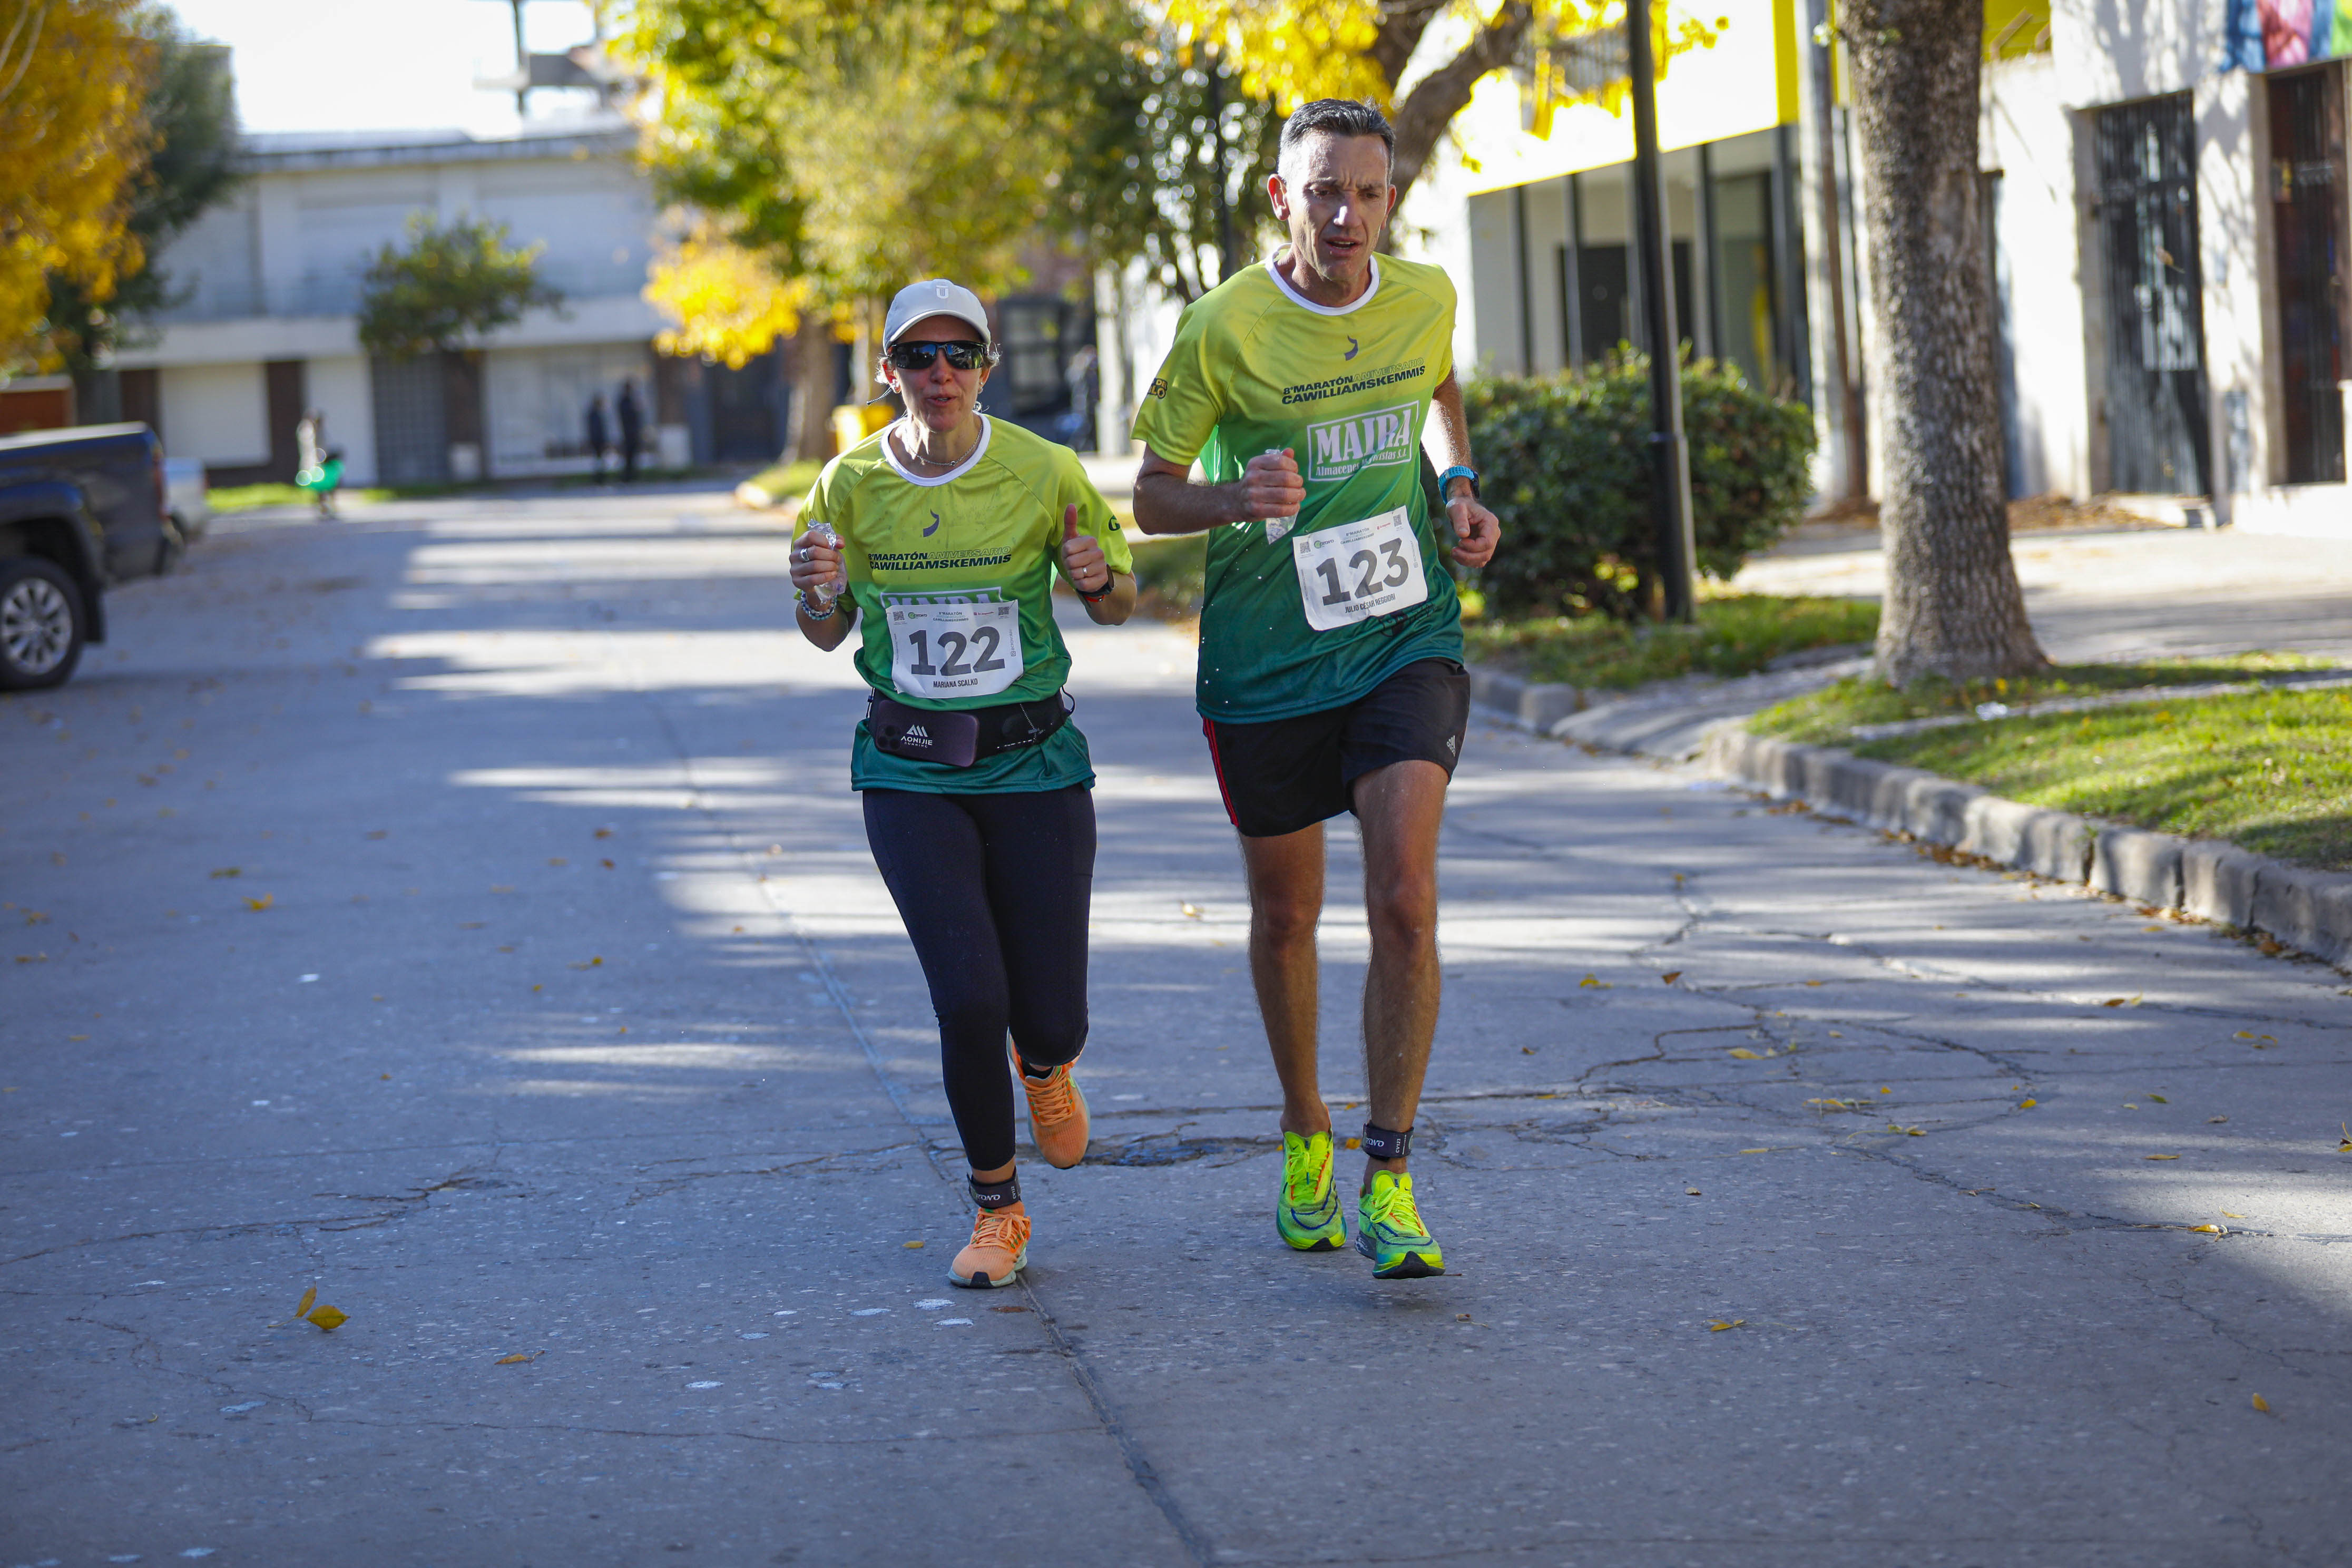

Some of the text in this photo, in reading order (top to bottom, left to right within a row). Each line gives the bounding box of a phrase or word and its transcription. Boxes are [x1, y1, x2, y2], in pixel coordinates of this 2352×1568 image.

[1282, 366, 1425, 404] CAWILLIAMSKEMMIS
[870, 554, 1012, 571] CAWILLIAMSKEMMIS
[1316, 537, 1409, 606] 123
[1345, 604, 1359, 613] JULIO
[909, 626, 1005, 676] 122
[958, 678, 978, 687] SCALKO
[901, 736, 933, 746] AONIJIE
